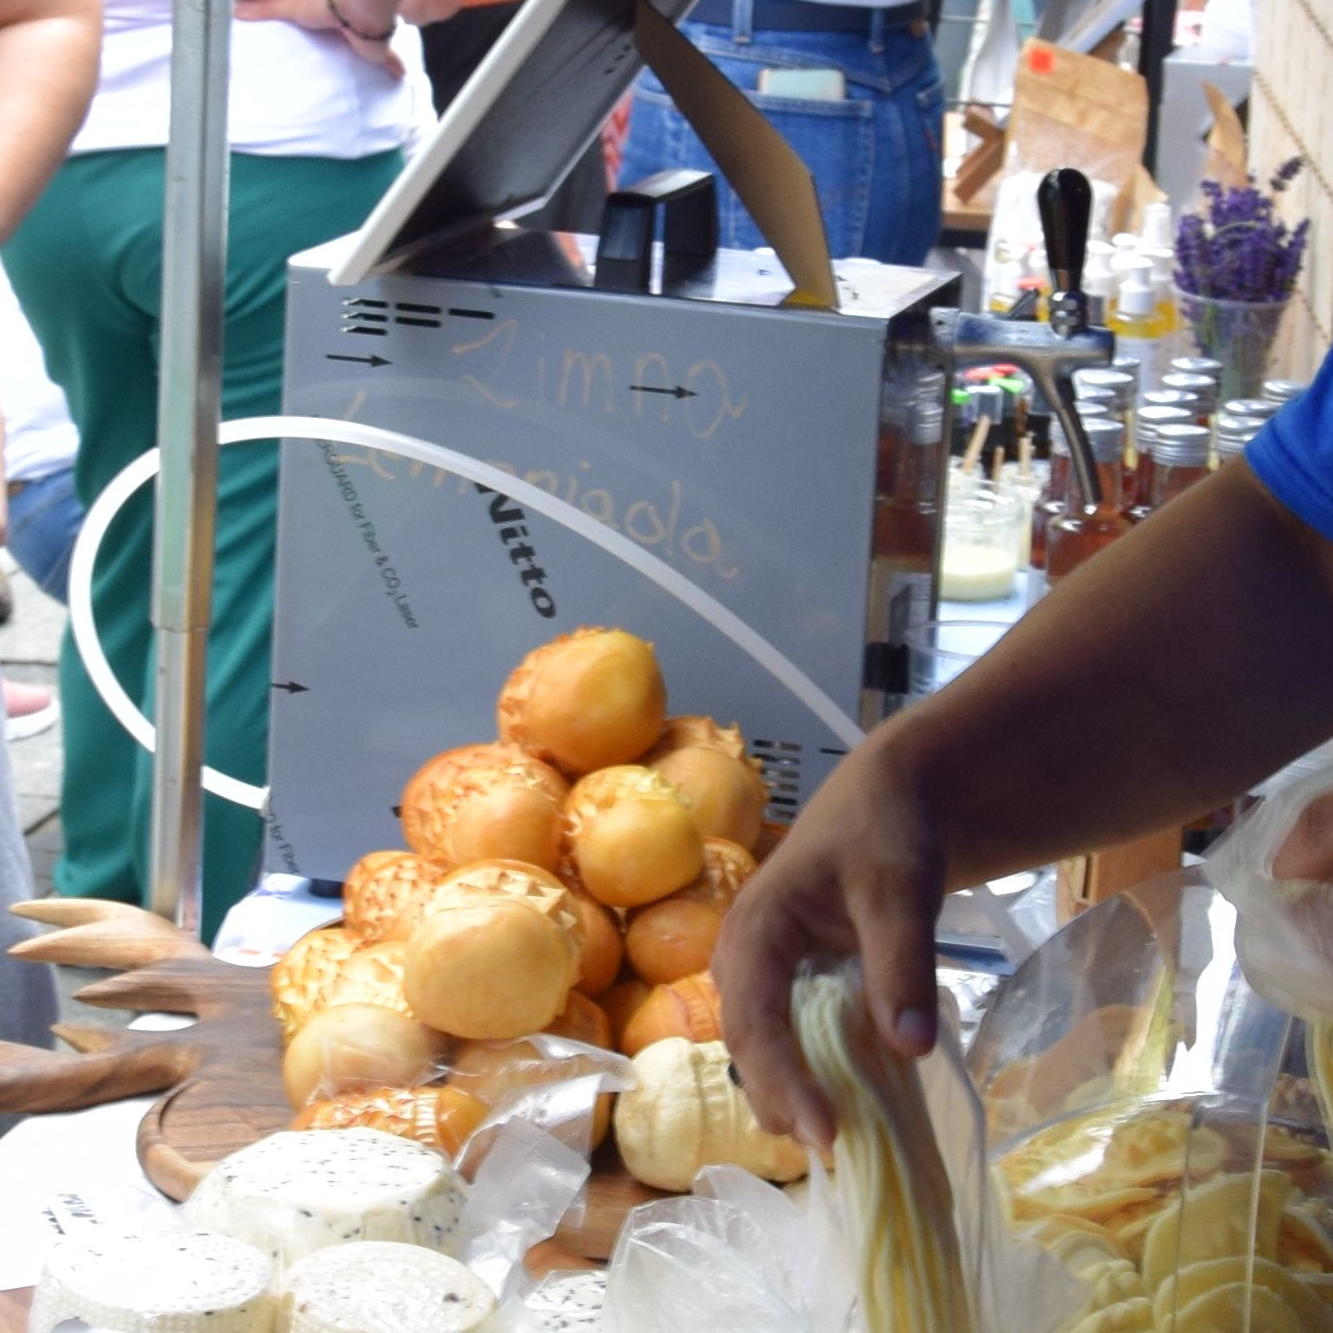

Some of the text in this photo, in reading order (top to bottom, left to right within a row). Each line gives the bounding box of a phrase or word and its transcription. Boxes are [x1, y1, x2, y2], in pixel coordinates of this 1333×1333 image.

[358, 521, 382, 554] Fiber
[394, 595, 419, 630] Laser
[472, 477, 557, 620] Nitto
